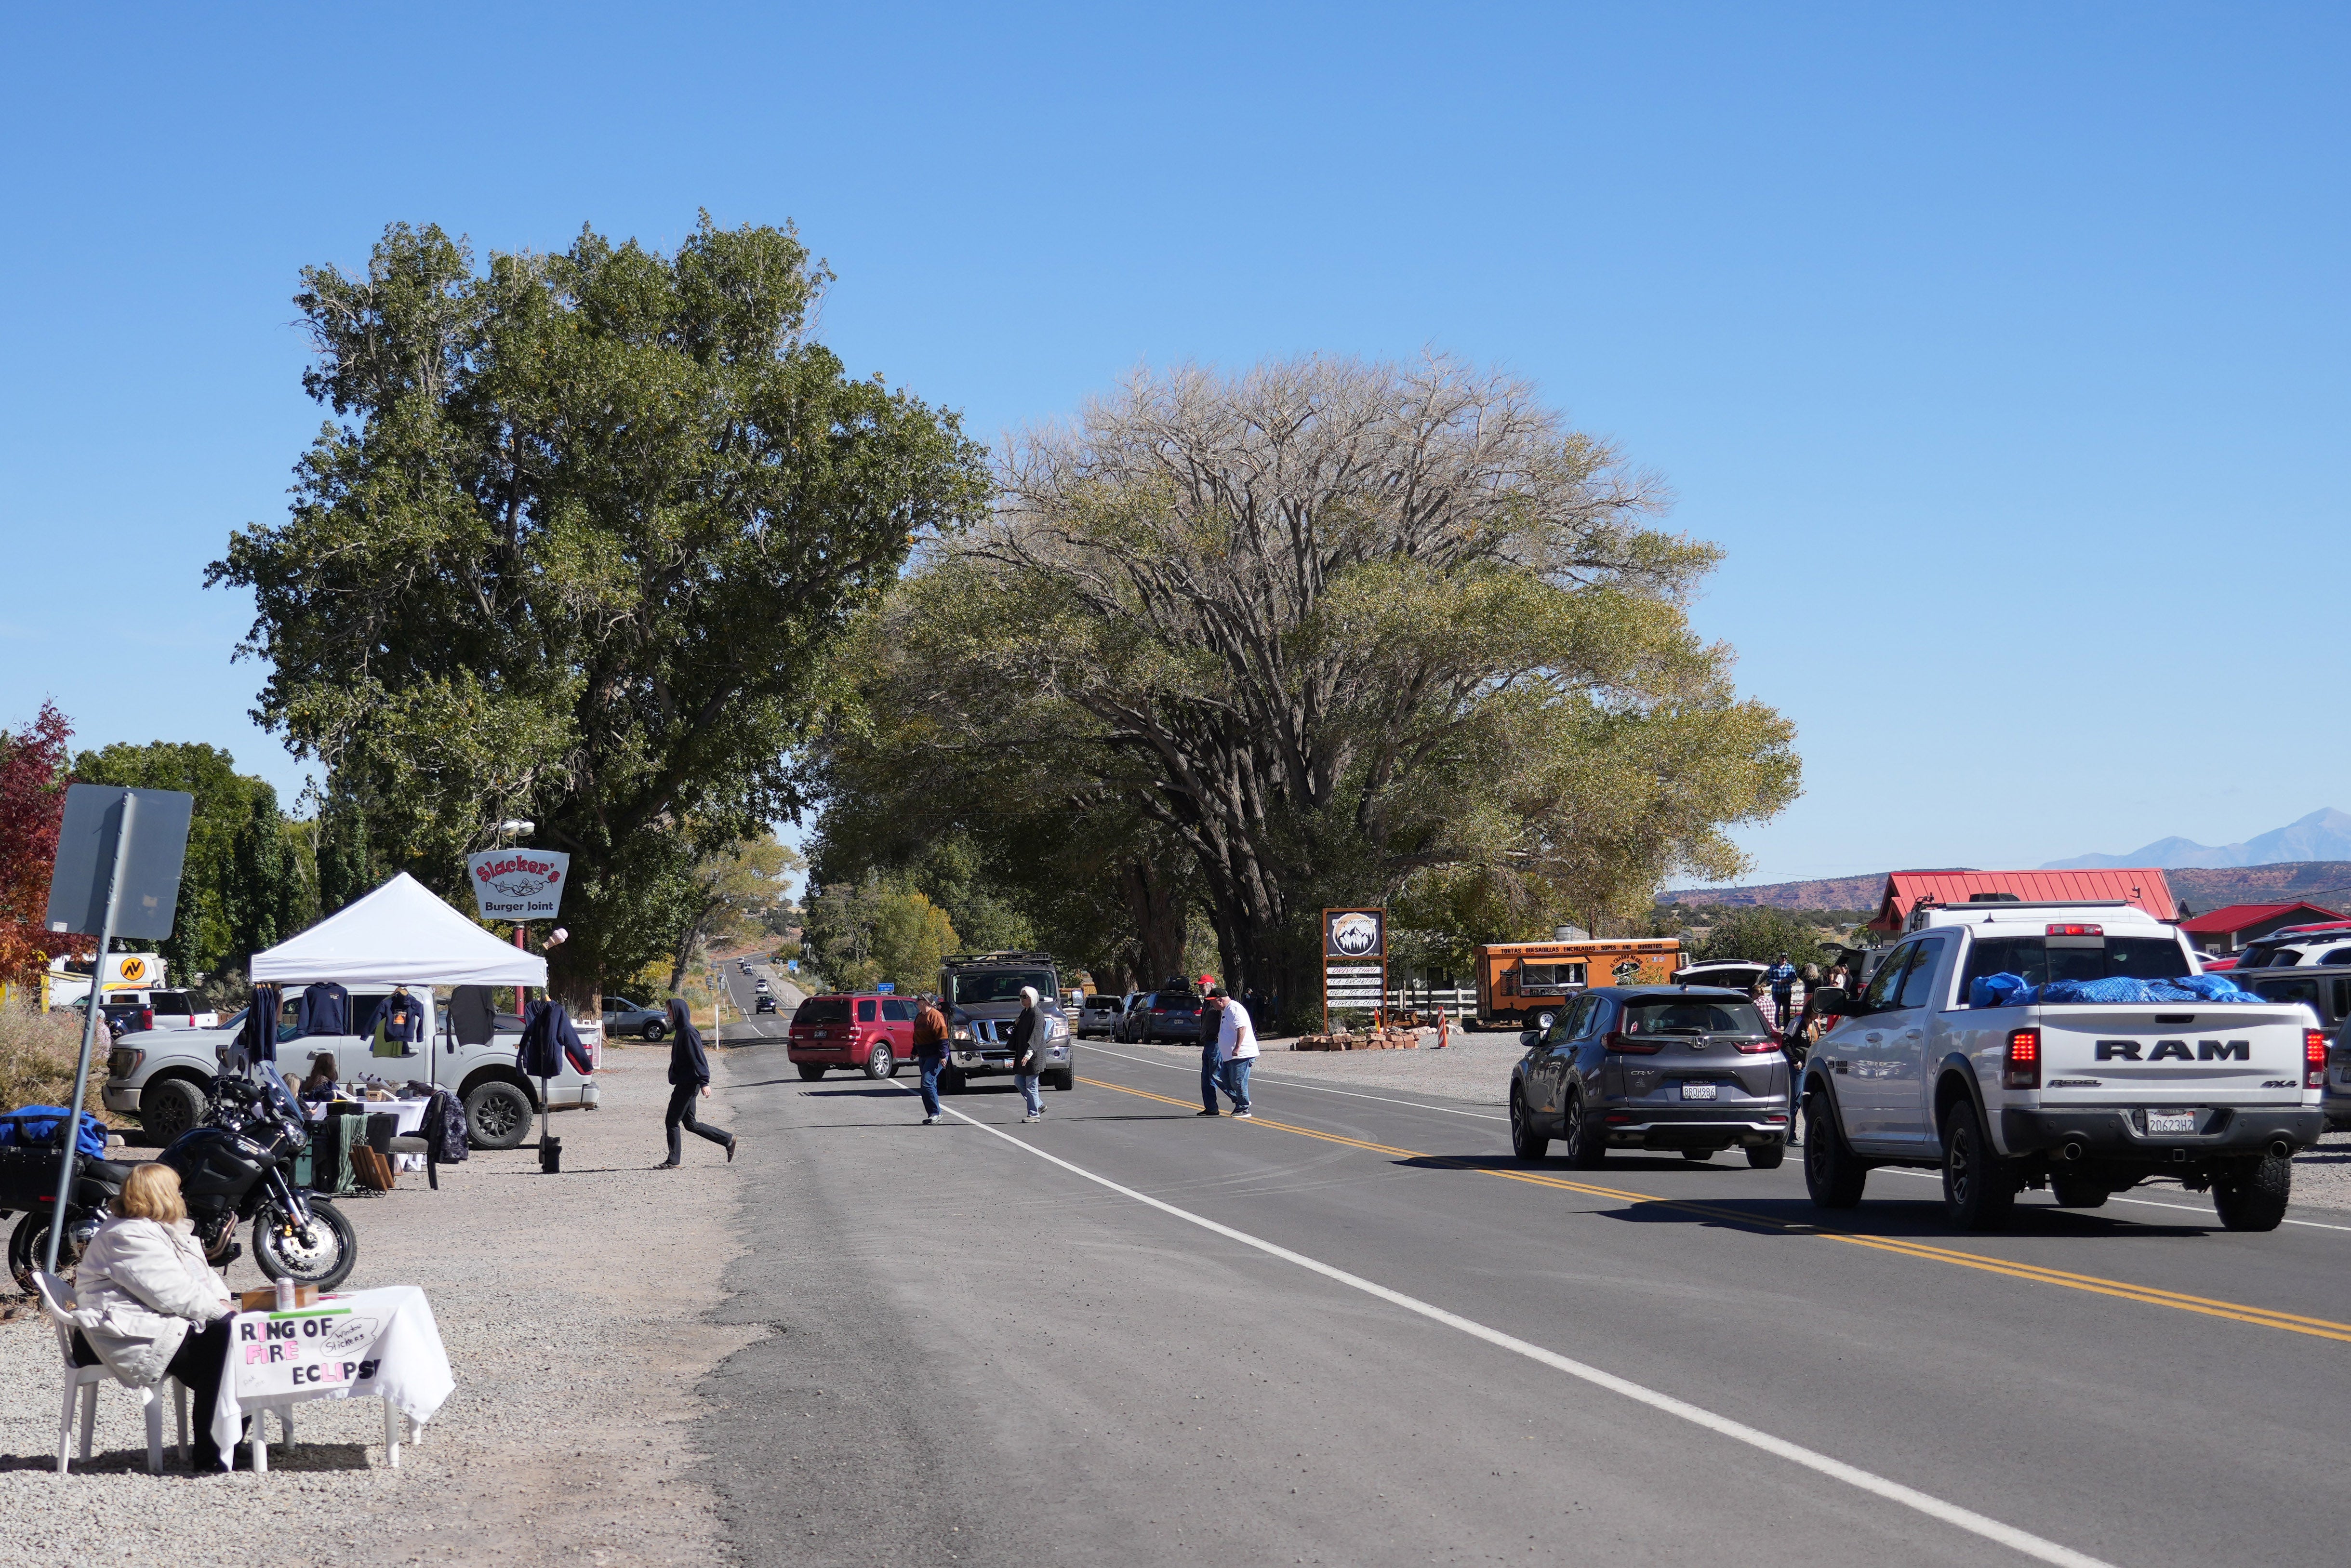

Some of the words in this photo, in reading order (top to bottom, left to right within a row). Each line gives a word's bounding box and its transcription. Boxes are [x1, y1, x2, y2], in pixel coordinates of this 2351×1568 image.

[476, 855, 560, 882] Slacker's
[485, 902, 524, 912] Burger
[527, 902, 554, 911] Joint
[1630, 955, 1643, 965] NEGRO
[2094, 1040, 2250, 1061] RAM
[2046, 1079, 2102, 1088] REBEL
[2150, 1119, 2192, 1131] 20623H2
[241, 1320, 295, 1342] RING
[303, 1317, 332, 1337] OF
[335, 1324, 362, 1339] Window
